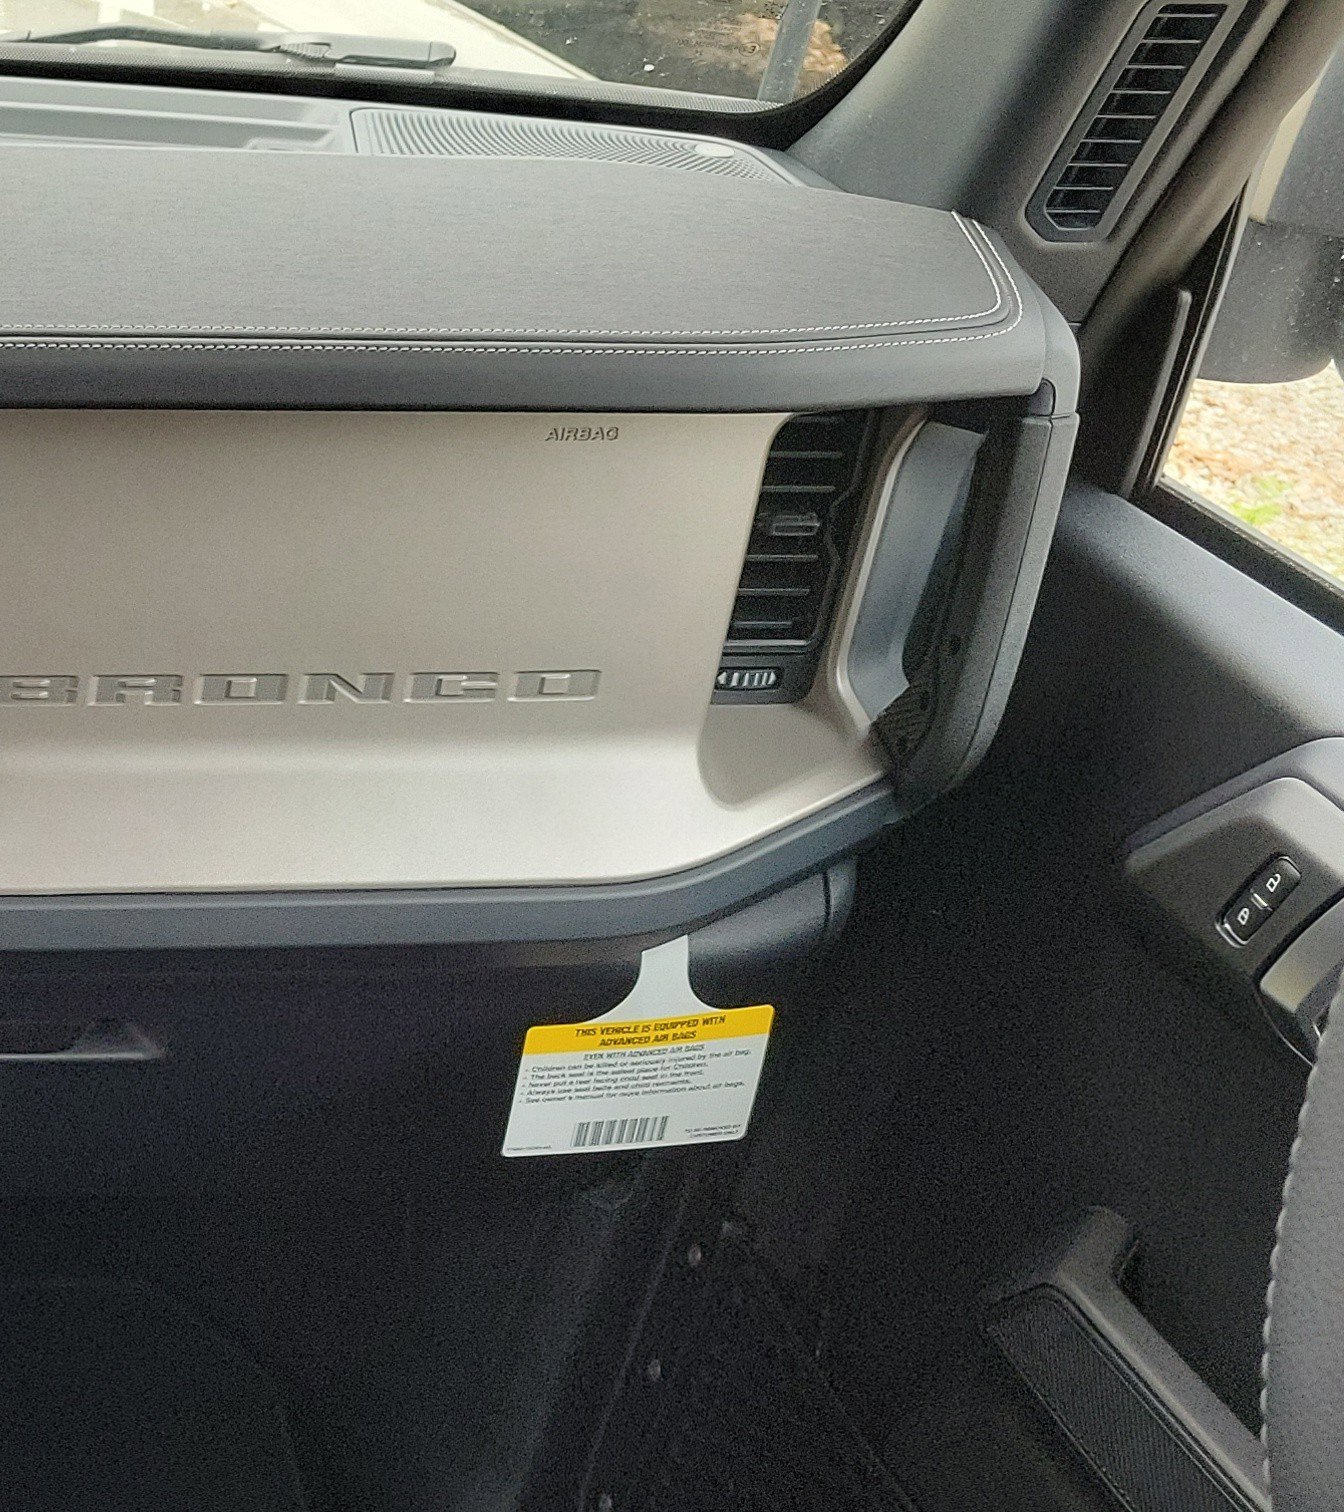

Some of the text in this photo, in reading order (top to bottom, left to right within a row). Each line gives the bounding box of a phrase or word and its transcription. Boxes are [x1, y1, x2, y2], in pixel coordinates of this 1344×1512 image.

[545, 426, 619, 441] AIRBAG
[575, 1015, 726, 1037] THIS VEHICLE IS EQUIPPED WITH
[599, 1031, 696, 1047] ADVANCED AIR BAGS
